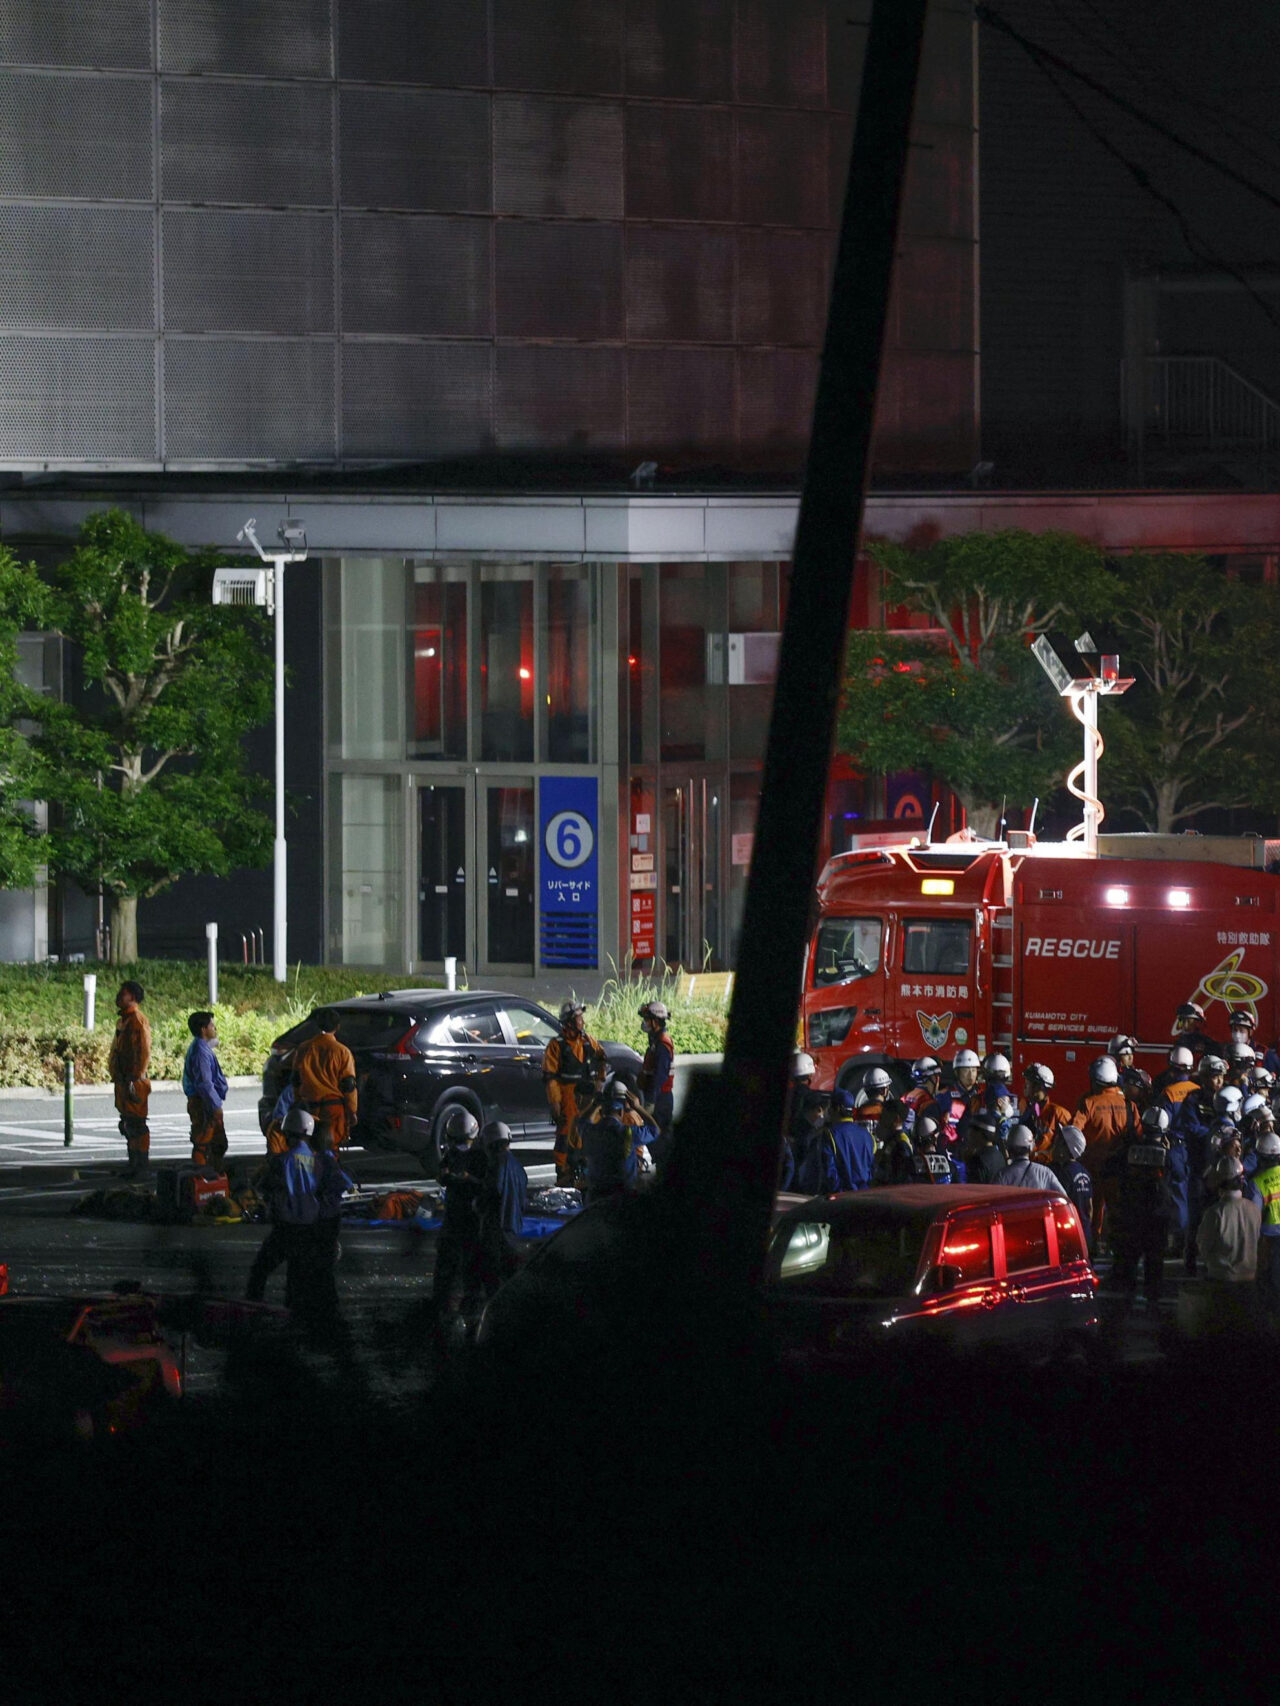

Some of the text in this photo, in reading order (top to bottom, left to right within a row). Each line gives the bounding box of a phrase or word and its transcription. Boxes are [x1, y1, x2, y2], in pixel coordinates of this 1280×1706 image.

[557, 819, 581, 860] 6
[548, 880, 591, 891] リバーサイド
[1217, 931, 1270, 946] 特別救助隊
[1025, 937, 1121, 959] RESCUE
[900, 984, 969, 999] 熊本市消防局
[1024, 1011, 1089, 1020] KUMAMOTO CITY
[1027, 1023, 1119, 1033] FIRE SERVICES BUREAU
